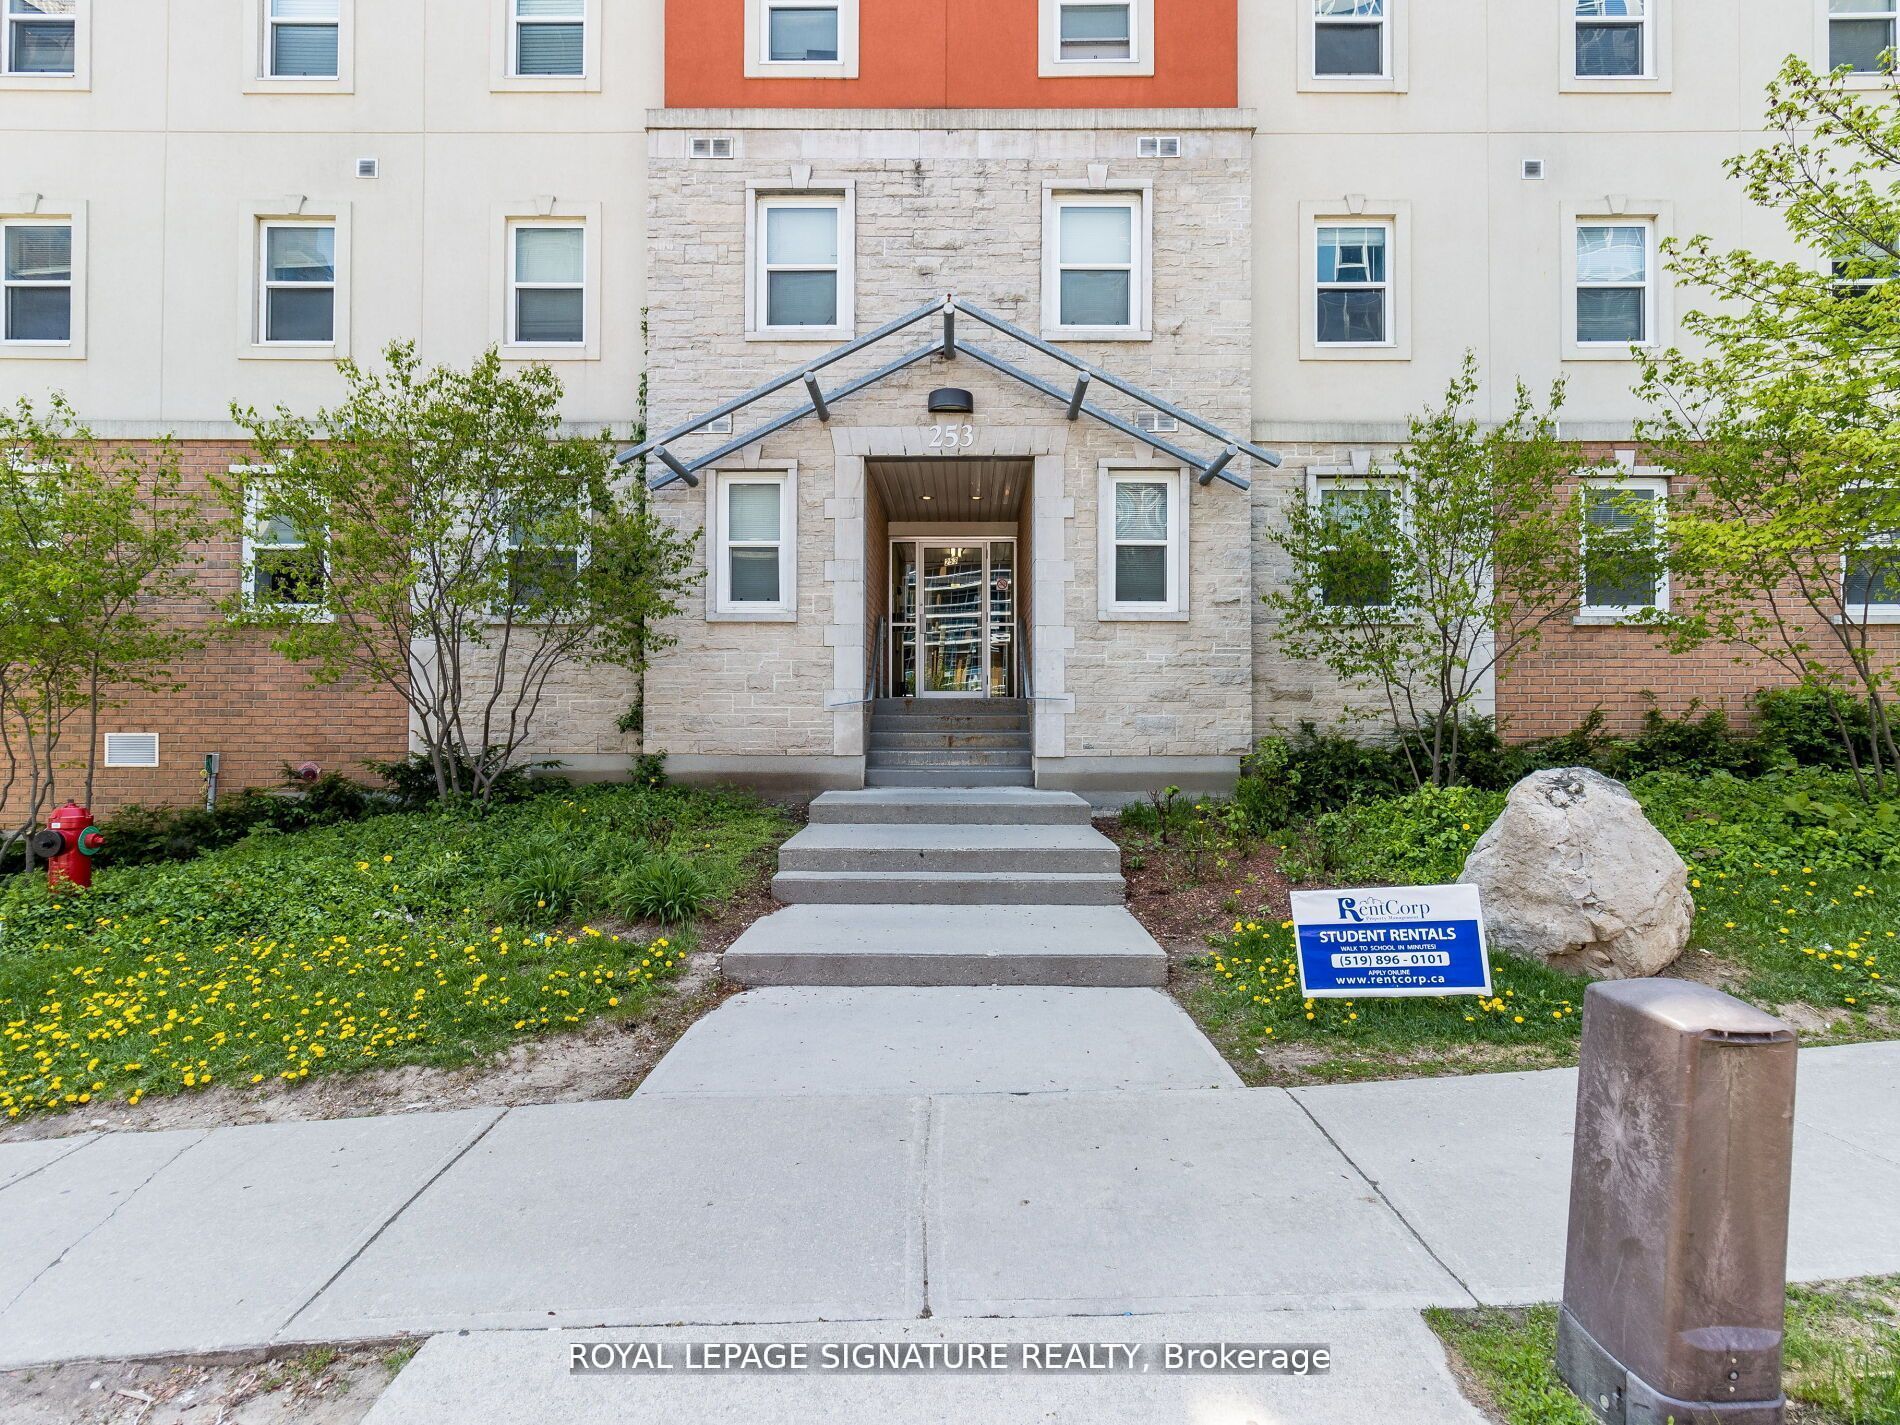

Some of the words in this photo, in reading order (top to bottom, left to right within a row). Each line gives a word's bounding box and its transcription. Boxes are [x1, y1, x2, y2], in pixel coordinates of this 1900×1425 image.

[929, 424, 974, 447] 253
[1337, 897, 1430, 922] RentCorp
[1319, 929, 1387, 943] STUDENT
[1390, 927, 1457, 941] RENTALS
[1339, 955, 1372, 967] (519)
[1375, 955, 1400, 965] 896
[1410, 954, 1443, 964] 0101
[1335, 975, 1445, 985] www.rentcorp.ca
